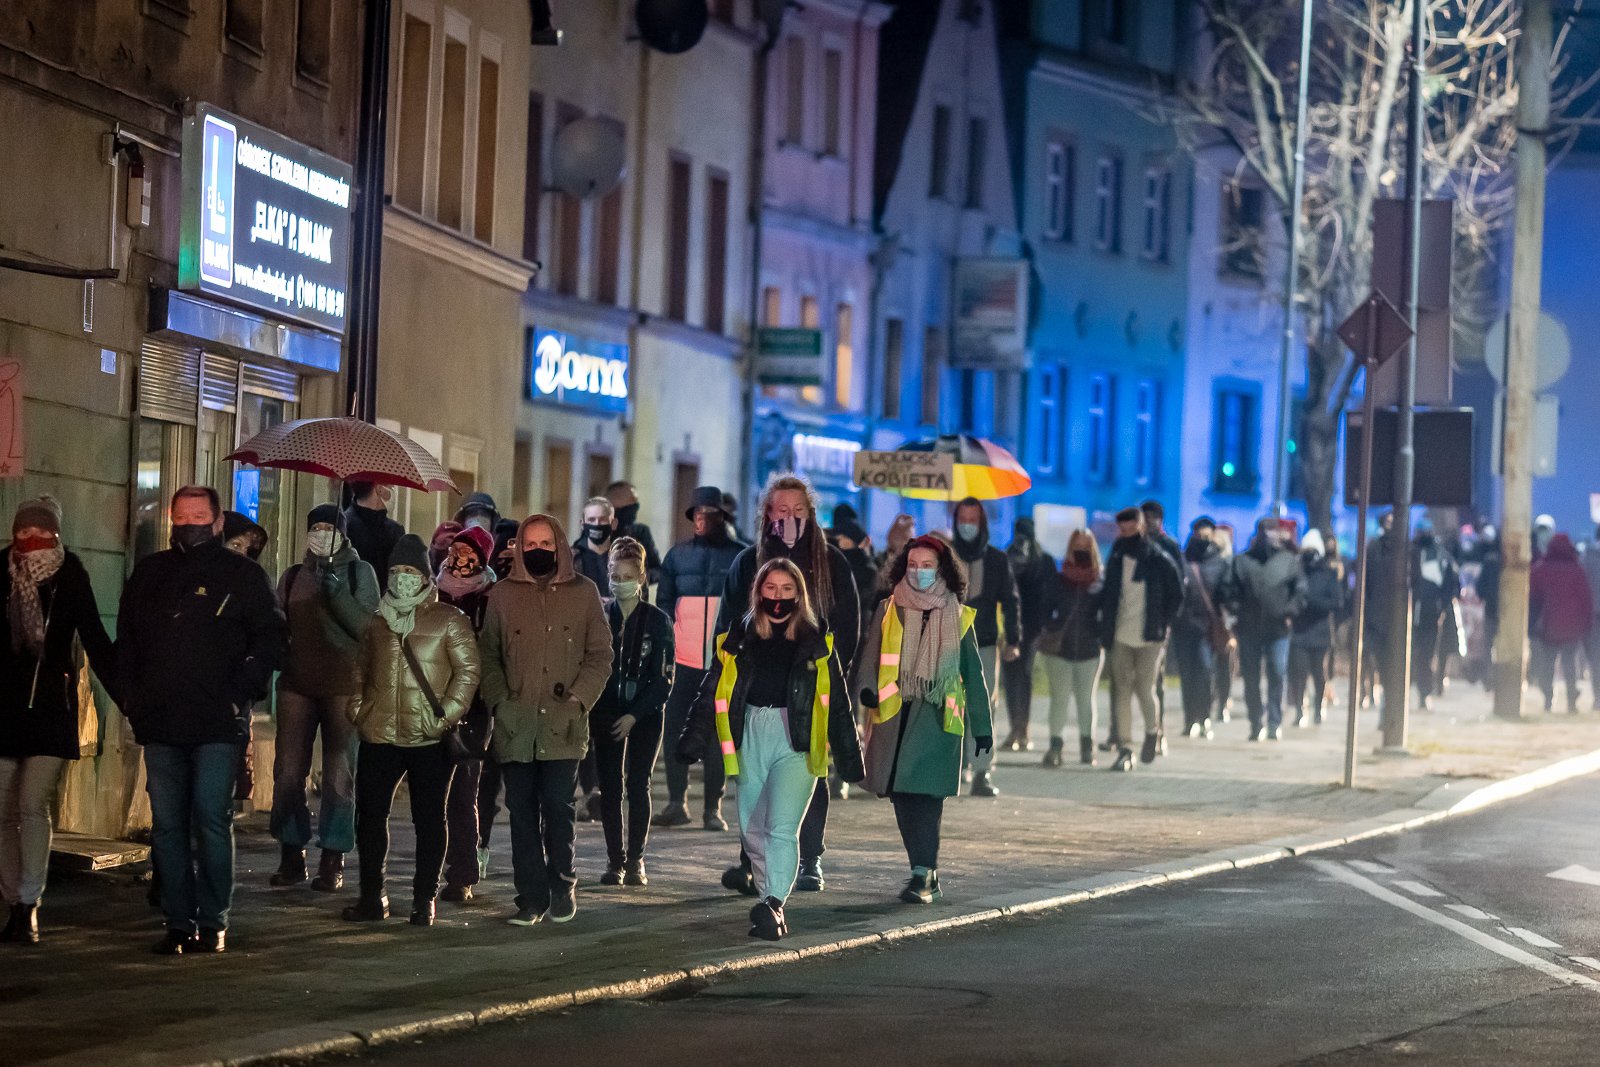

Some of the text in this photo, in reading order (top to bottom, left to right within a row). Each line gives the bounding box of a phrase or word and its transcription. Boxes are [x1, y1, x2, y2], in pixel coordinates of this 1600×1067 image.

[288, 212, 298, 251] P.
[297, 217, 333, 264] BUJAK
[561, 350, 628, 399] OPTYK
[860, 468, 949, 490] KOBIETA
